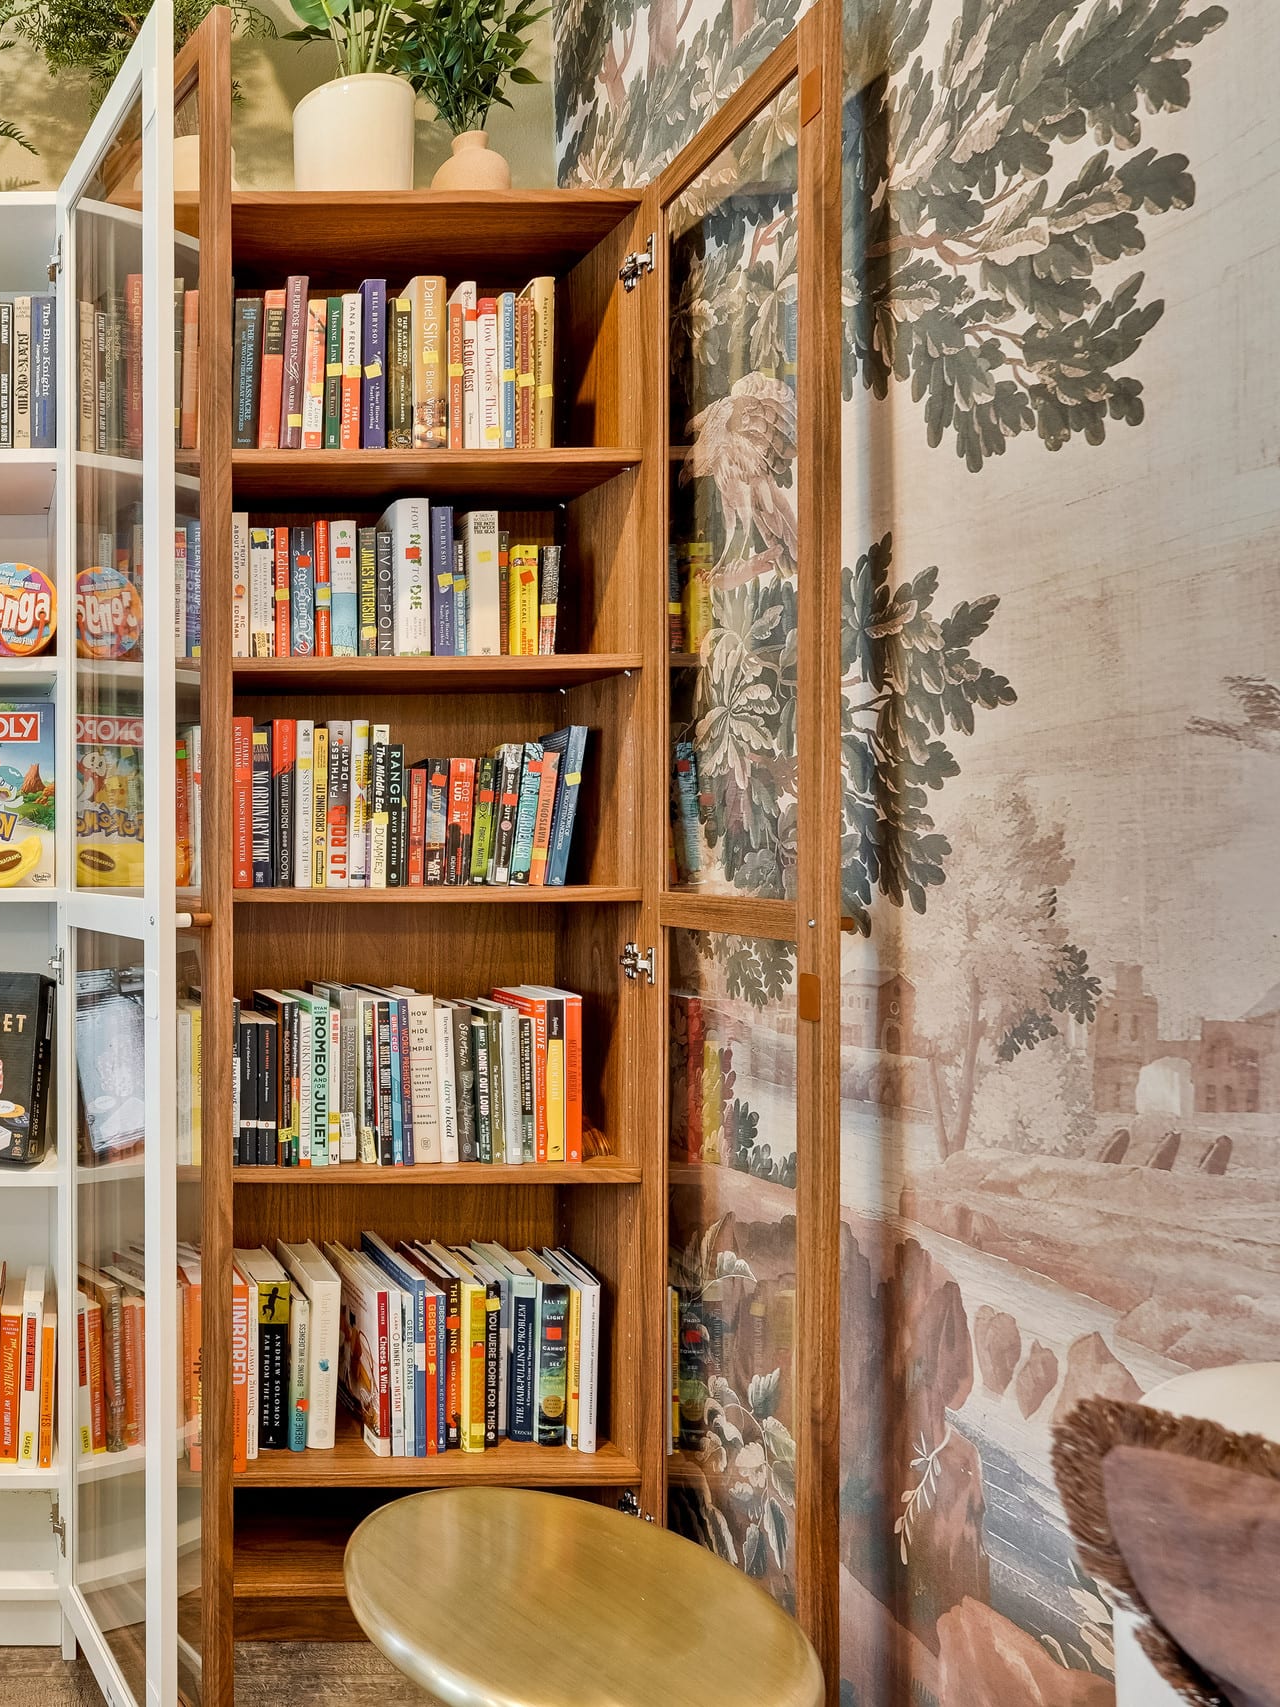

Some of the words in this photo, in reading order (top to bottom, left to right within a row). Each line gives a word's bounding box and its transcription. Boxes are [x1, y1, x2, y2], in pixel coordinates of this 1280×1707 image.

[423, 279, 437, 320] Daniel
[42, 303, 51, 325] The
[348, 301, 356, 326] TANA
[42, 328, 51, 353] Blue
[348, 330, 356, 366] FRENCH
[423, 322, 438, 353] Silva
[1, 373, 9, 394] DEATH
[41, 356, 51, 396] Knight
[425, 371, 434, 394] Black
[1, 395, 9, 410] HAD
[425, 397, 434, 427] Widow
[1, 410, 9, 423] TWO
[1, 425, 9, 442] SONS
[411, 505, 419, 531] HOW
[277, 551, 288, 588] Editor
[361, 548, 374, 577] JAMES
[361, 578, 374, 624] PATTERSON
[252, 770, 269, 785] NO
[330, 741, 339, 798] FAITHLESS
[390, 751, 401, 804] RANGE
[315, 783, 324, 794] IT!
[252, 786, 269, 836] ORDINARY
[315, 794, 325, 832] CRUSHING
[252, 839, 269, 863] TIME
[427, 861, 435, 881] MILE
[314, 1016, 327, 1076] ROMEO
[401, 1028, 409, 1054] WORLD
[536, 1018, 544, 1050] DRIVE
[478, 1048, 488, 1075] MONEY
[401, 1056, 411, 1099] PREHISTORY
[479, 1077, 489, 1093] OUT
[480, 1095, 489, 1116] LOUD
[314, 1090, 326, 1148] JULIET
[428, 1303, 436, 1334] GEEK
[489, 1311, 497, 1331] YOU
[406, 1319, 414, 1353] GREENS
[428, 1334, 436, 1357] DAD
[488, 1332, 497, 1359] WERE
[379, 1336, 388, 1364] Cheese
[393, 1342, 401, 1367] DINNER
[380, 1374, 389, 1394] Wine
[406, 1357, 414, 1390] GRAINS
[488, 1360, 497, 1386] BORN
[394, 1385, 402, 1412] INSTANT
[487, 1388, 496, 1407] FOR
[487, 1409, 496, 1430] THIS
